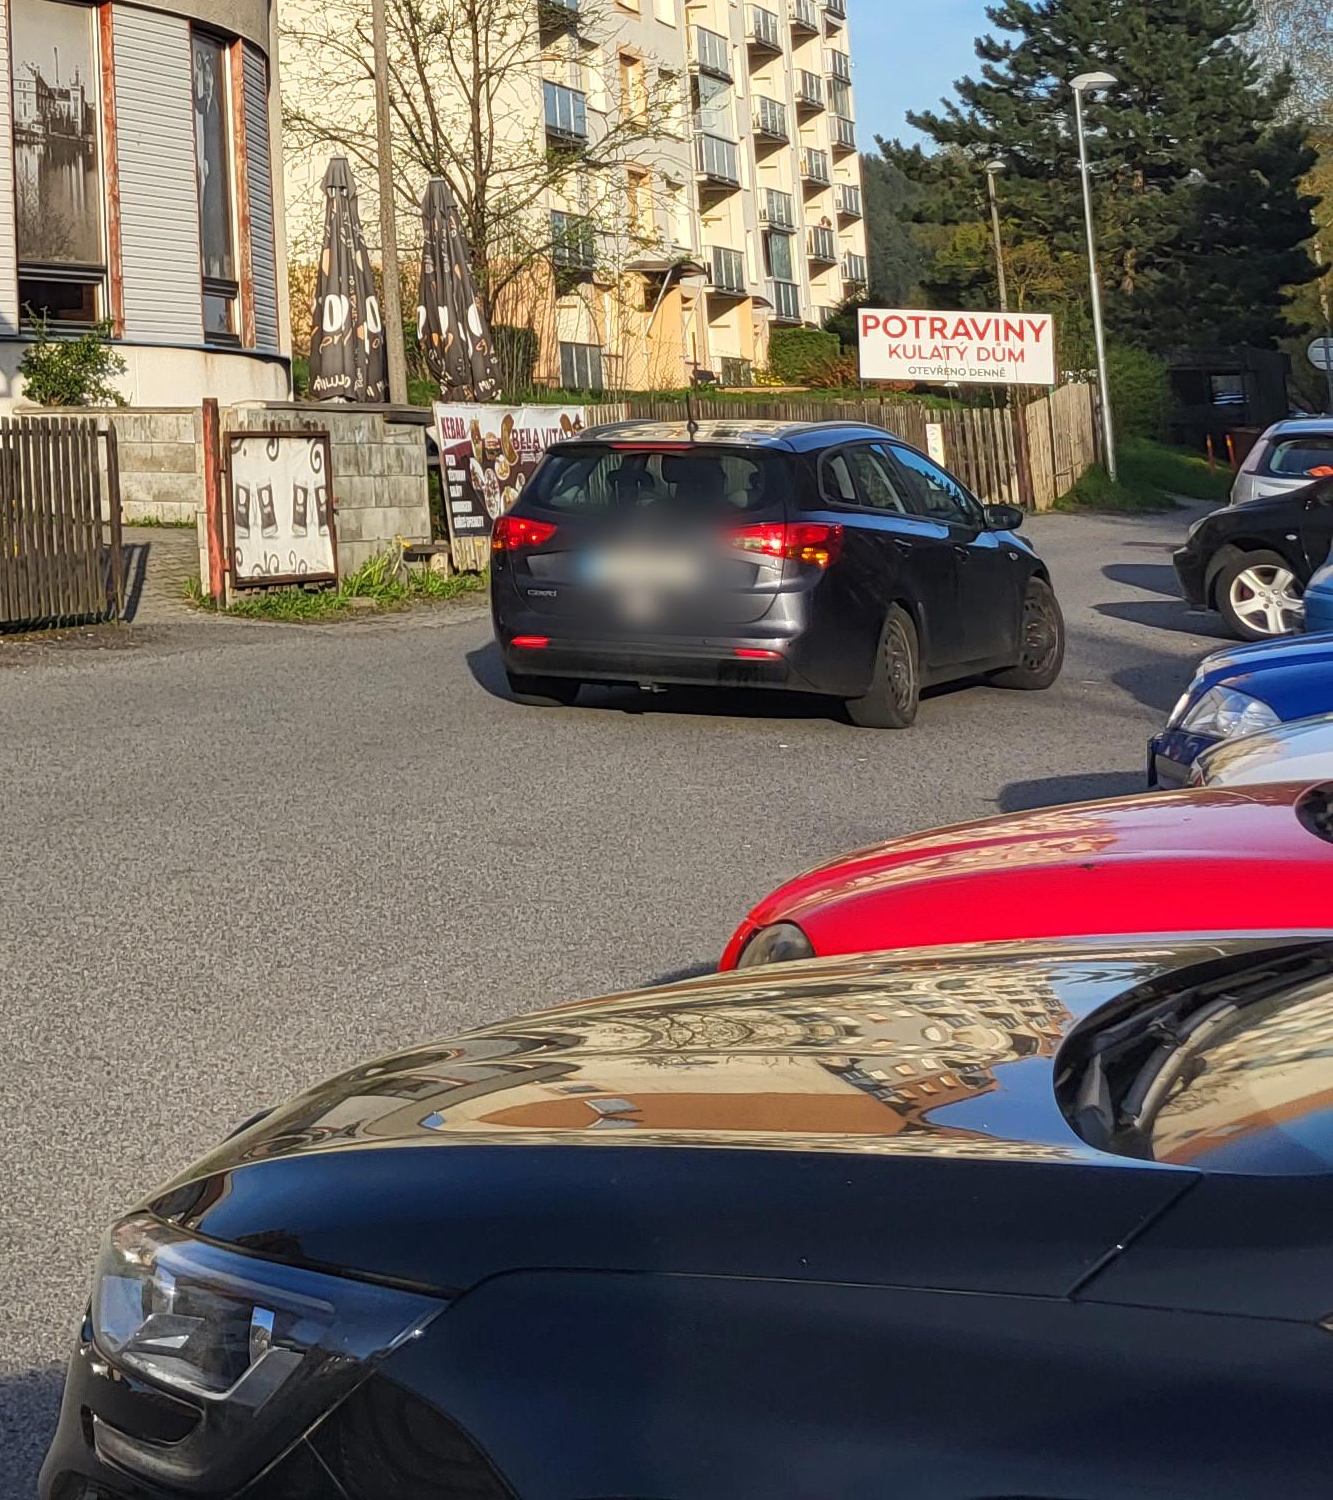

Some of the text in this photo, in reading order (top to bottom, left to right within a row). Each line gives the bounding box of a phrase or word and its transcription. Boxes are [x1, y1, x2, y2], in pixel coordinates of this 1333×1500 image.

[861, 314, 1048, 343] POTRAVINY
[888, 341, 1025, 363] KULATÝ DŮM
[907, 364, 1006, 378] OTEVŘENO DENNĚ
[440, 416, 466, 440] KEBAB
[511, 427, 541, 451] BELLA
